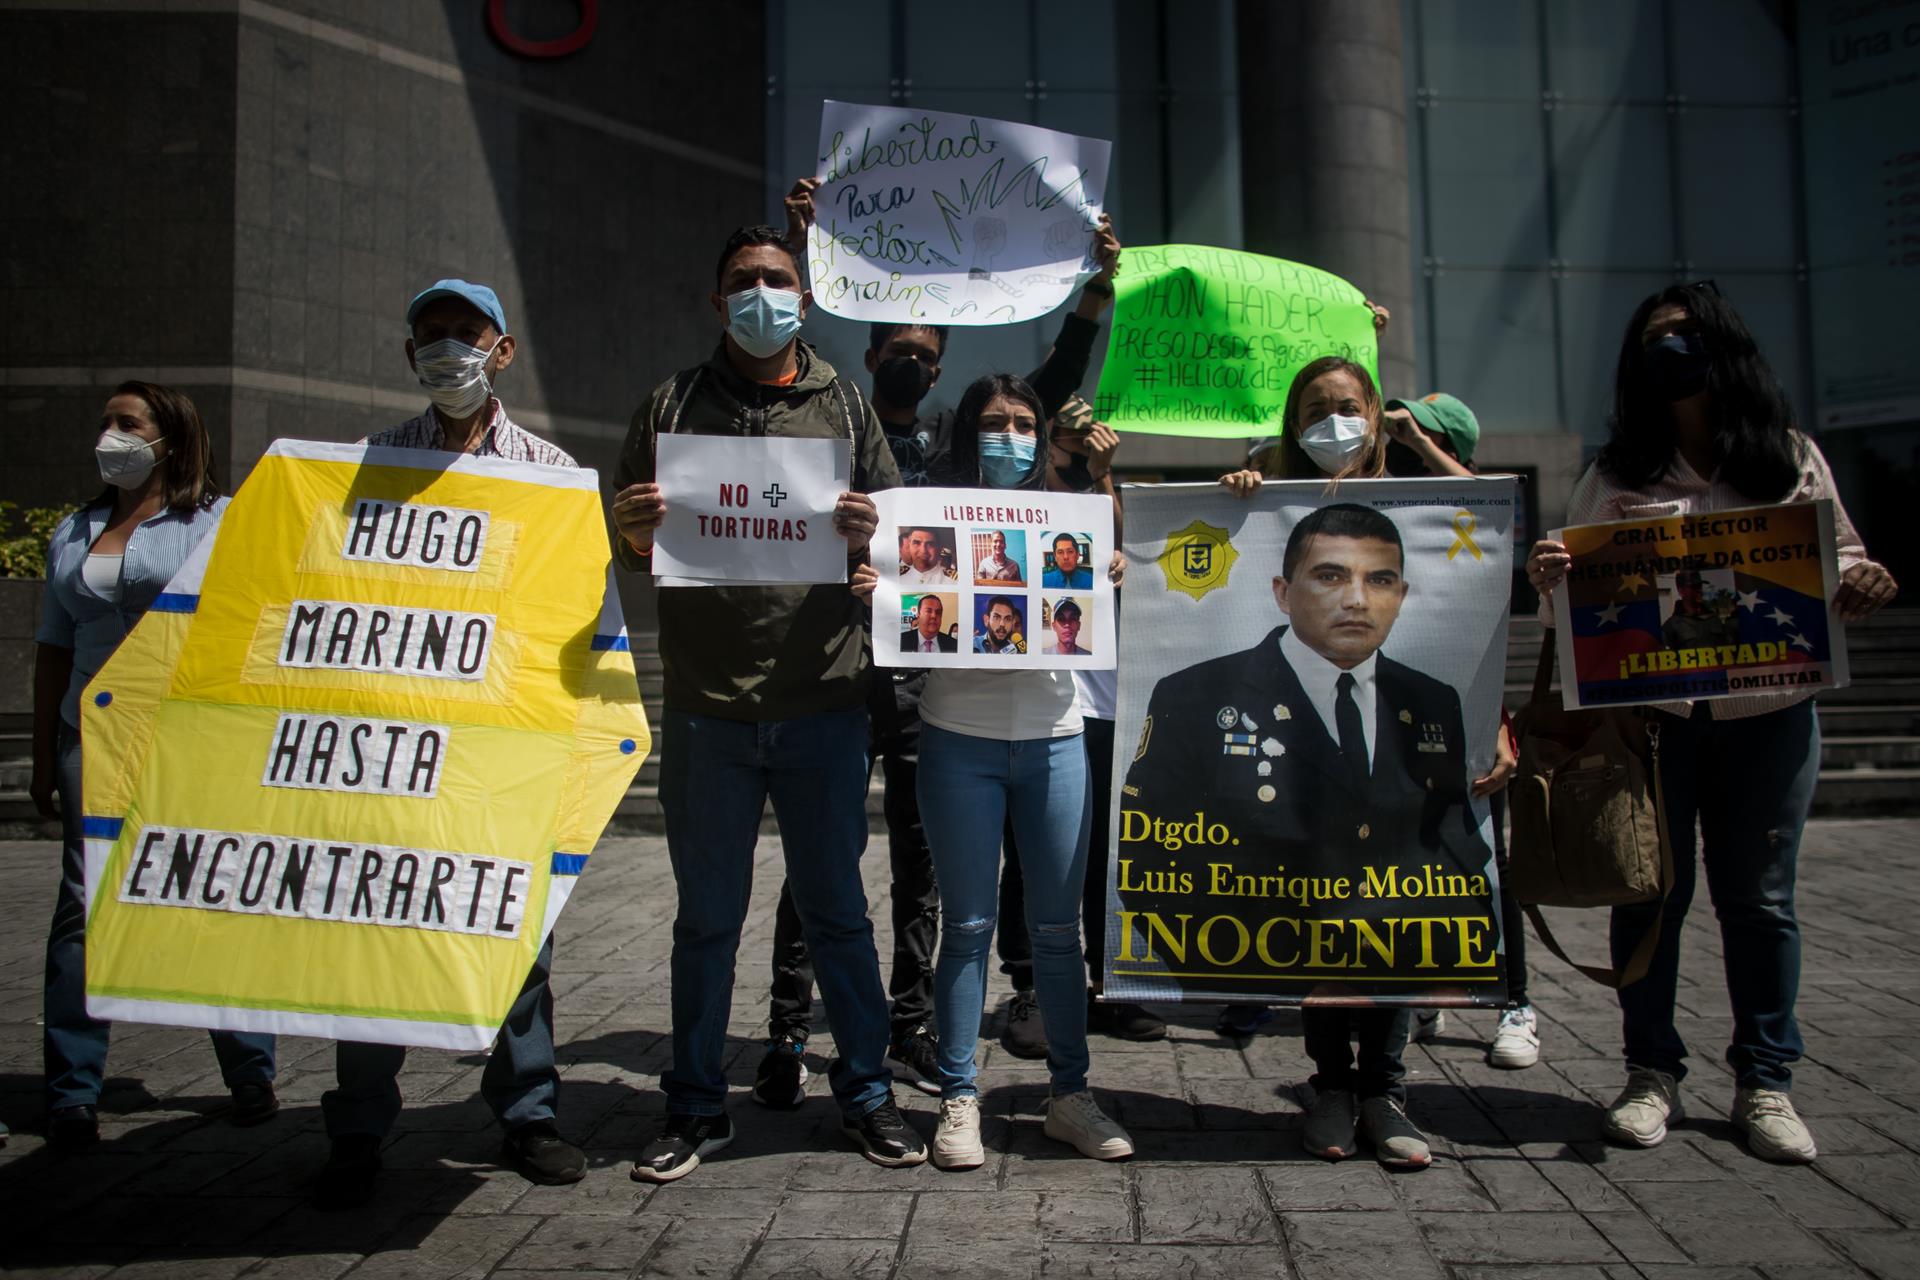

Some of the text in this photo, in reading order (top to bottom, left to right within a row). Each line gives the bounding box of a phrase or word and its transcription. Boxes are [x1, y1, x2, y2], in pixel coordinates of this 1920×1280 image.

[1829, 30, 1891, 66] Una
[836, 185, 915, 223] Para
[1129, 276, 1208, 321] JHON
[1113, 323, 1186, 360] PRESO
[1191, 331, 1258, 361] DESDE
[719, 483, 749, 508] NO
[944, 505, 1049, 525] ¡LIBERENLOS!
[1371, 496, 1511, 507] www.venezuelavigilante.com
[347, 503, 482, 566] HUGO
[698, 515, 808, 541] TORTURAS
[1612, 516, 1768, 546] GRAL. HÉCTOR
[1714, 551, 1745, 568] DA
[1749, 543, 1819, 563] COSTA
[286, 606, 488, 674] MARINO
[1619, 640, 1788, 680] ¡LIBERTAD!
[269, 718, 440, 793] HASTA
[1120, 810, 1240, 851] Dtgdo.
[128, 832, 528, 932] ENCONTRARTE
[1117, 859, 1489, 907] Luis Enrique Molina
[1113, 911, 1496, 968] INOCENTE
